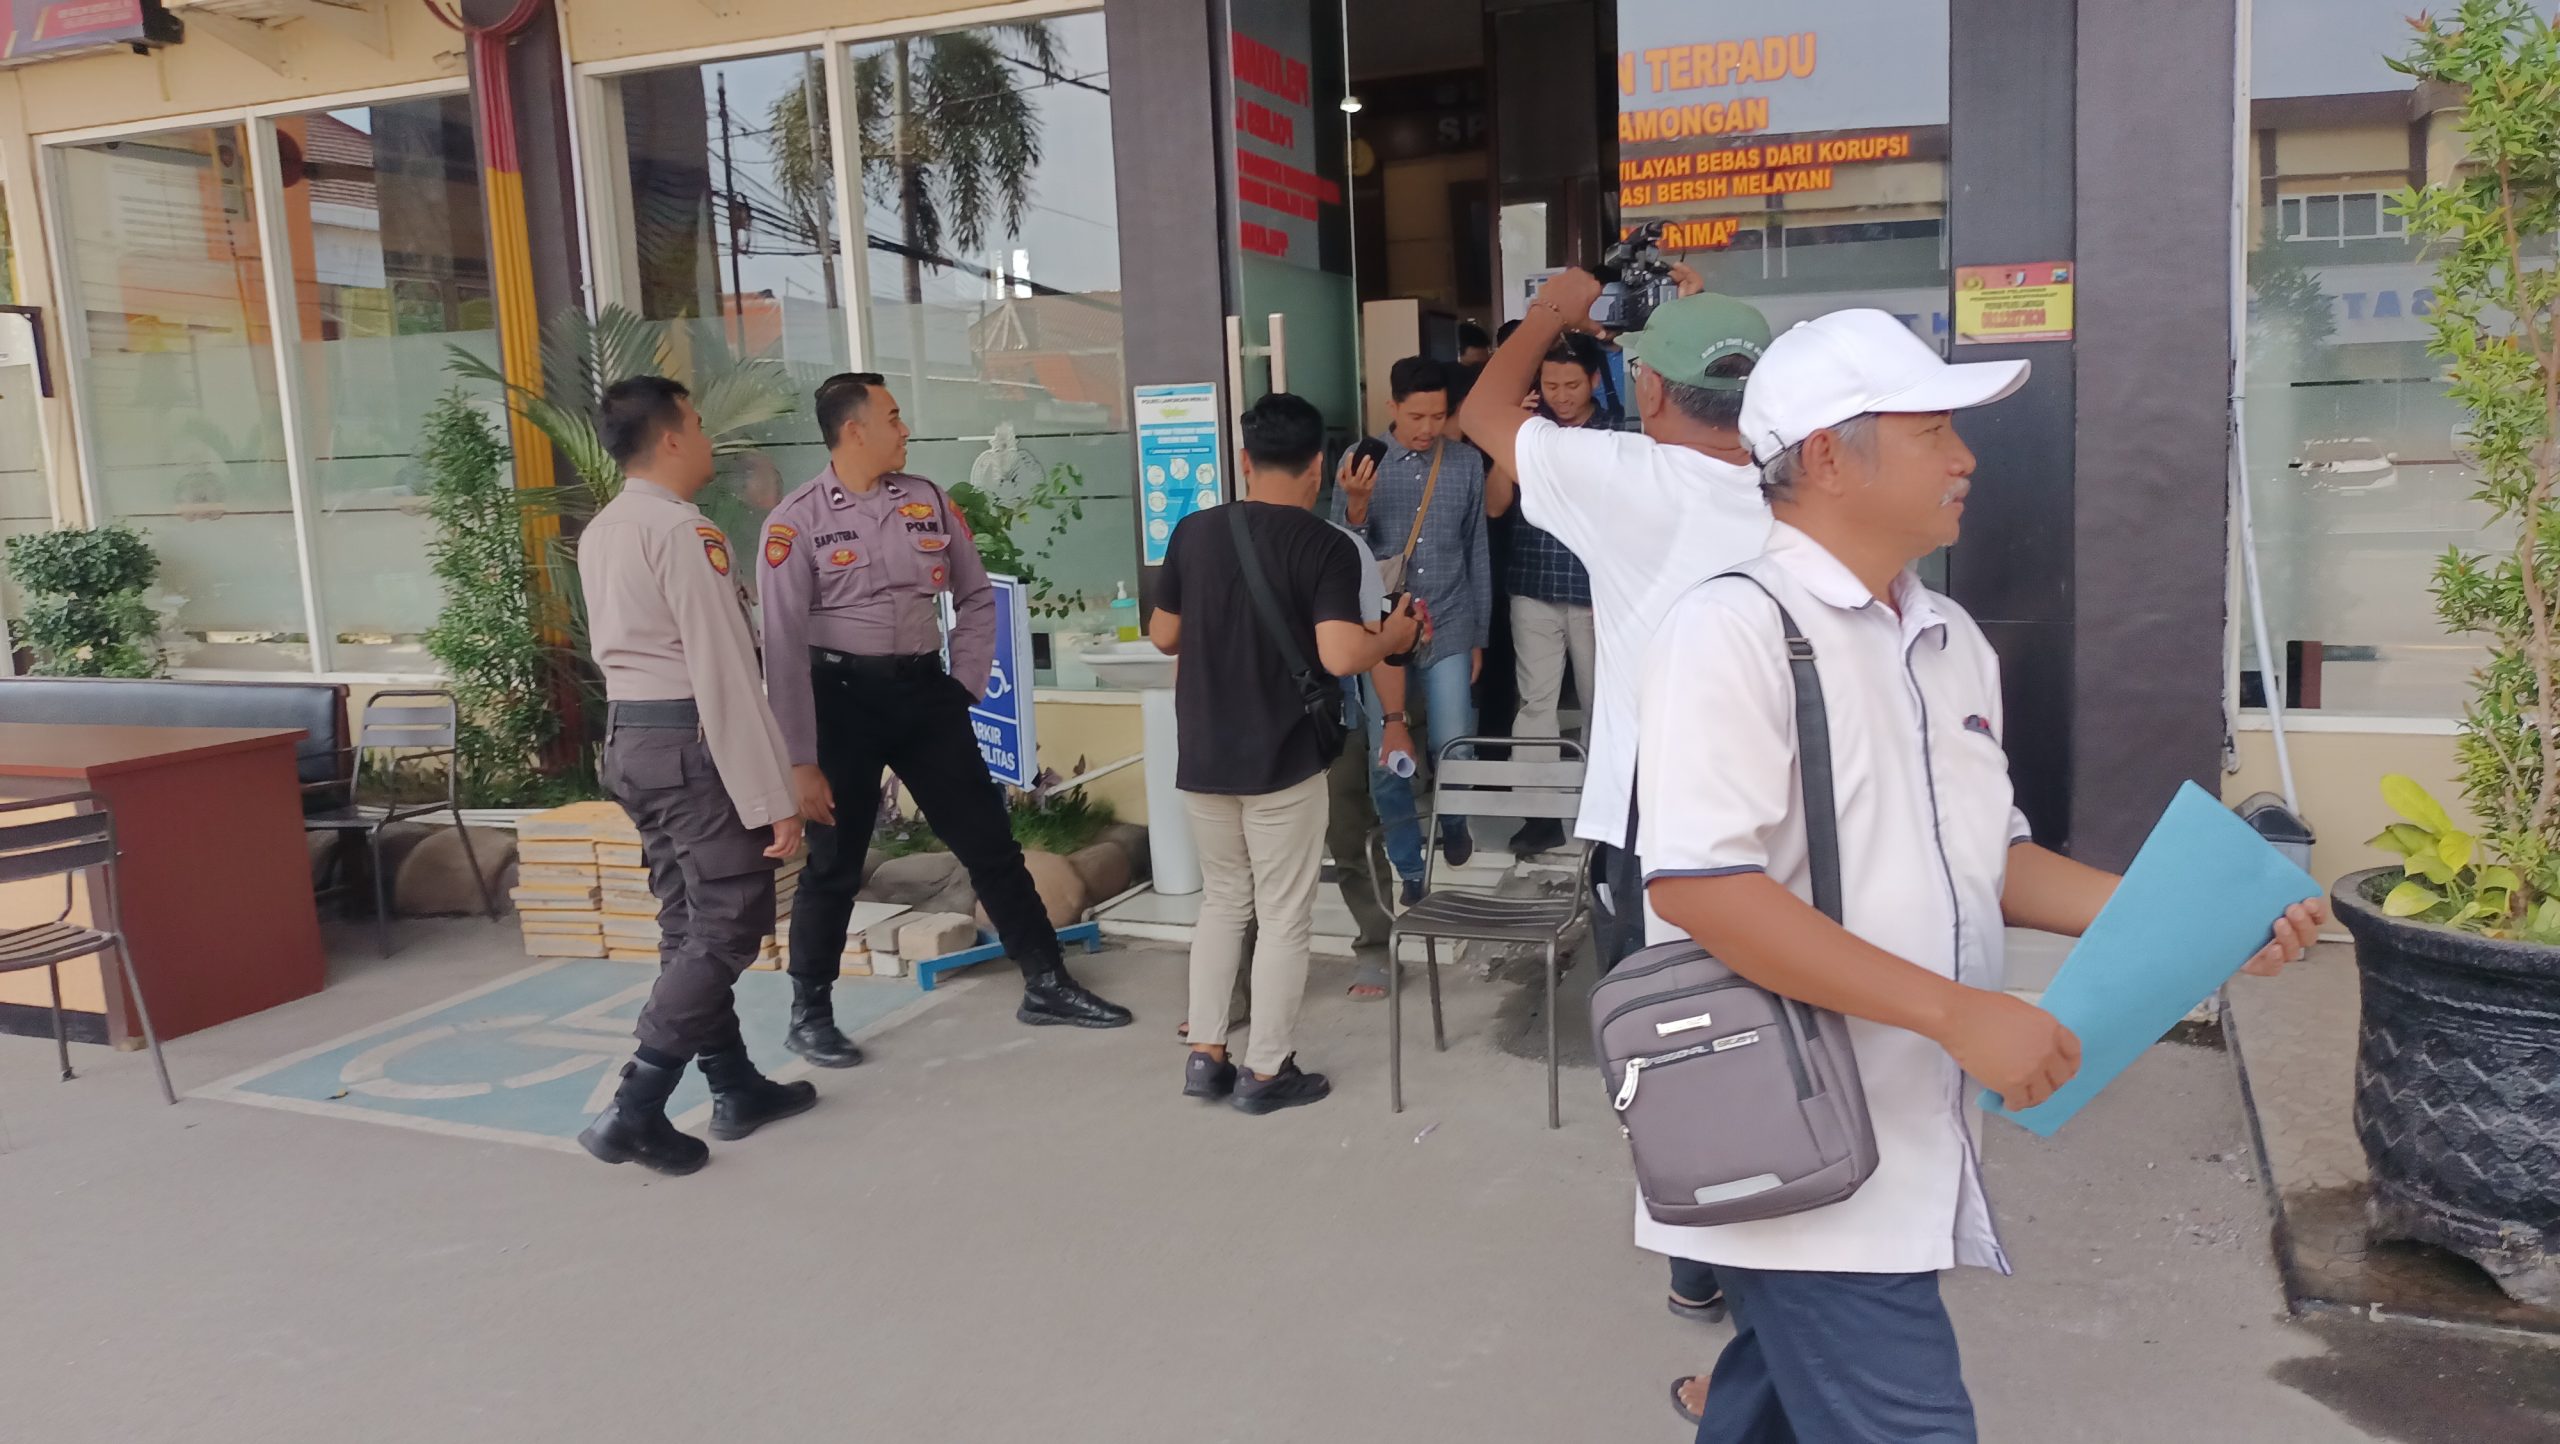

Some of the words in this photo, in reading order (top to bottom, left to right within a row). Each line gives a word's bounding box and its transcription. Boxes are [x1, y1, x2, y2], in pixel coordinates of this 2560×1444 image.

[1643, 32, 1817, 93] TERPADU
[1618, 97, 1770, 142] AMONGAN
[1696, 147, 1761, 174] BEBAS
[1765, 142, 1814, 168] DARI
[1818, 133, 1911, 163] KORUPSI
[1656, 177, 1728, 203] BERSIH
[1732, 168, 1833, 195] MELAYANI
